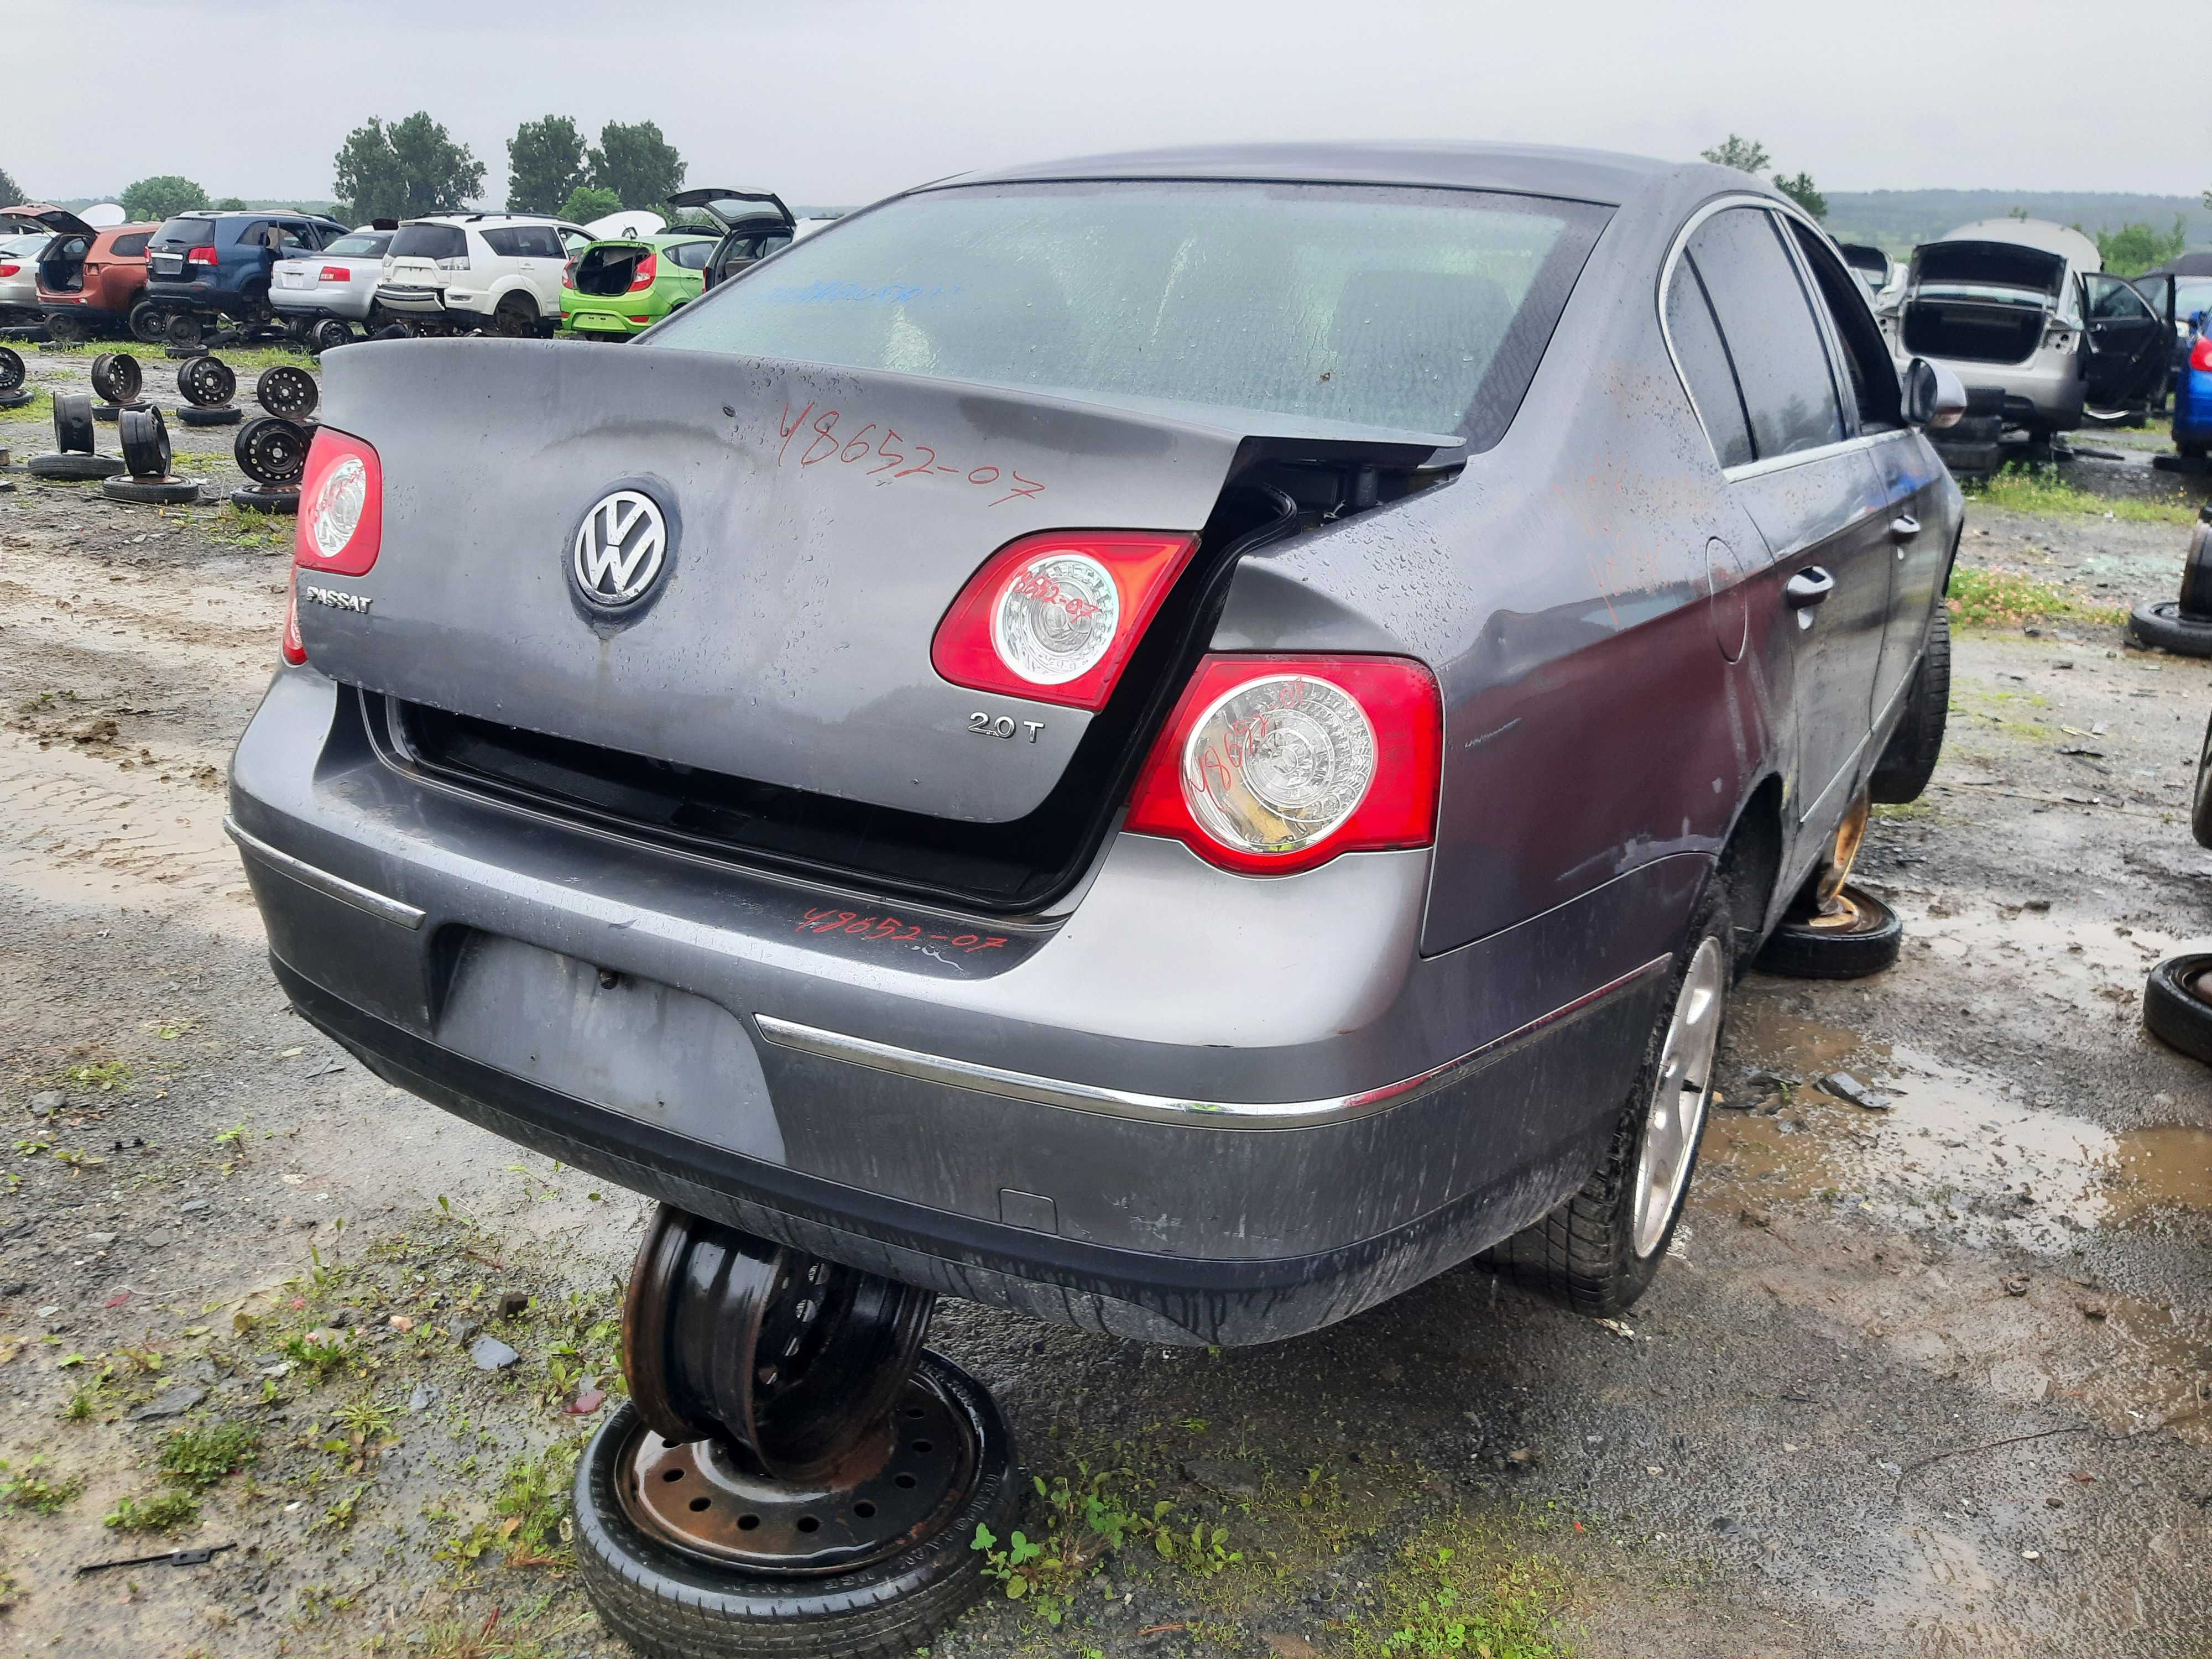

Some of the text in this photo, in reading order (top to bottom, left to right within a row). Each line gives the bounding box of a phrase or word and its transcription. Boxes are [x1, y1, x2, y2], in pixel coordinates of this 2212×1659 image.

[778, 401, 1045, 507] 48652-07
[306, 586, 373, 614] PASSAT
[796, 907, 1008, 953] 48652-07
